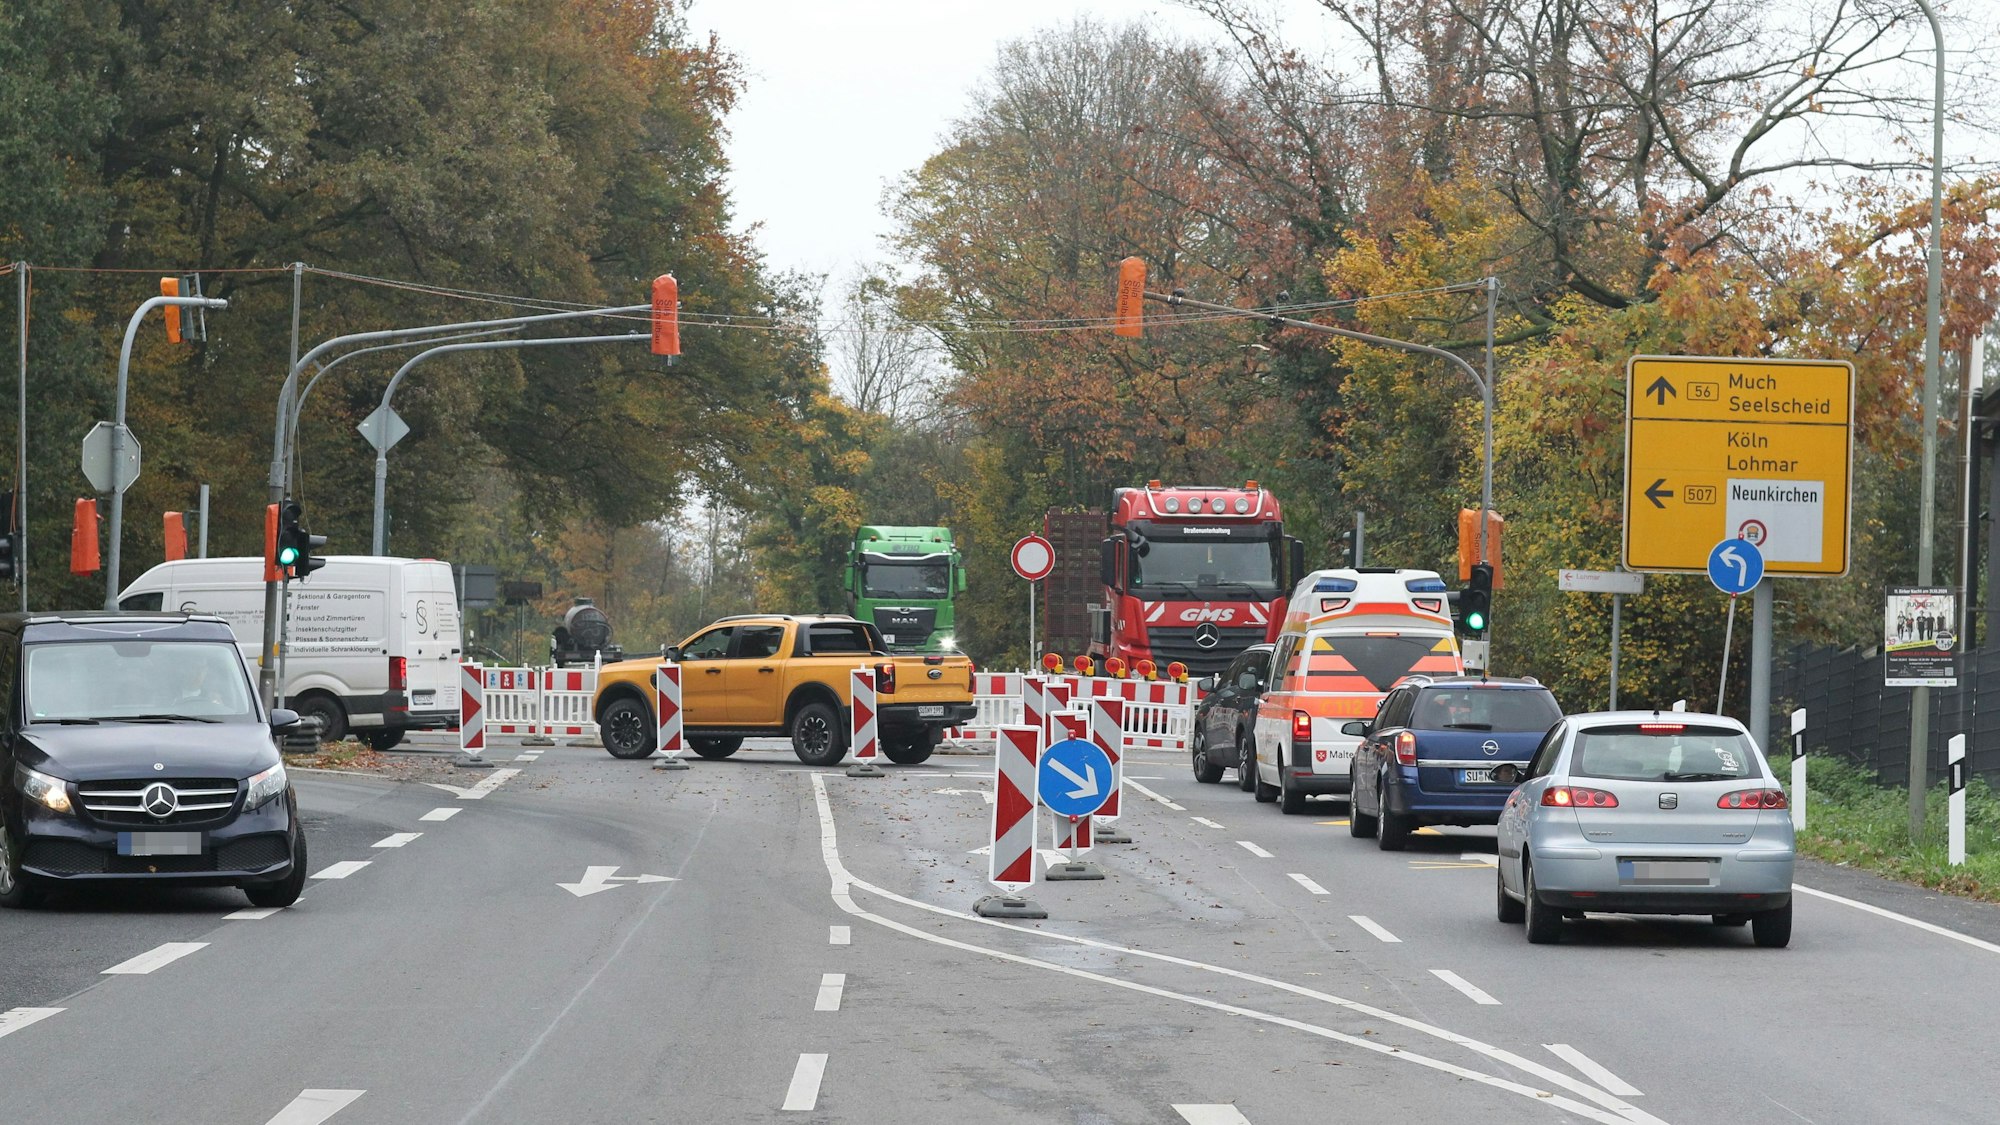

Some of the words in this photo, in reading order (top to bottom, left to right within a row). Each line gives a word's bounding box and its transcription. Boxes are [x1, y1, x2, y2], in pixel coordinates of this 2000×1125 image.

[1729, 373, 1777, 390] Much
[1695, 385, 1711, 398] 56
[1729, 396, 1830, 415] Seelscheid
[1728, 431, 1768, 448] Köln
[1727, 455, 1799, 472] Lohmar
[1688, 488, 1712, 501] 507
[1732, 485, 1818, 503] Neunkirchen
[1183, 527, 1231, 535] Straßenunterhaltung
[1180, 608, 1235, 621] GMS
[1329, 750, 1355, 758] Malte
[1466, 771, 1478, 781] SU
